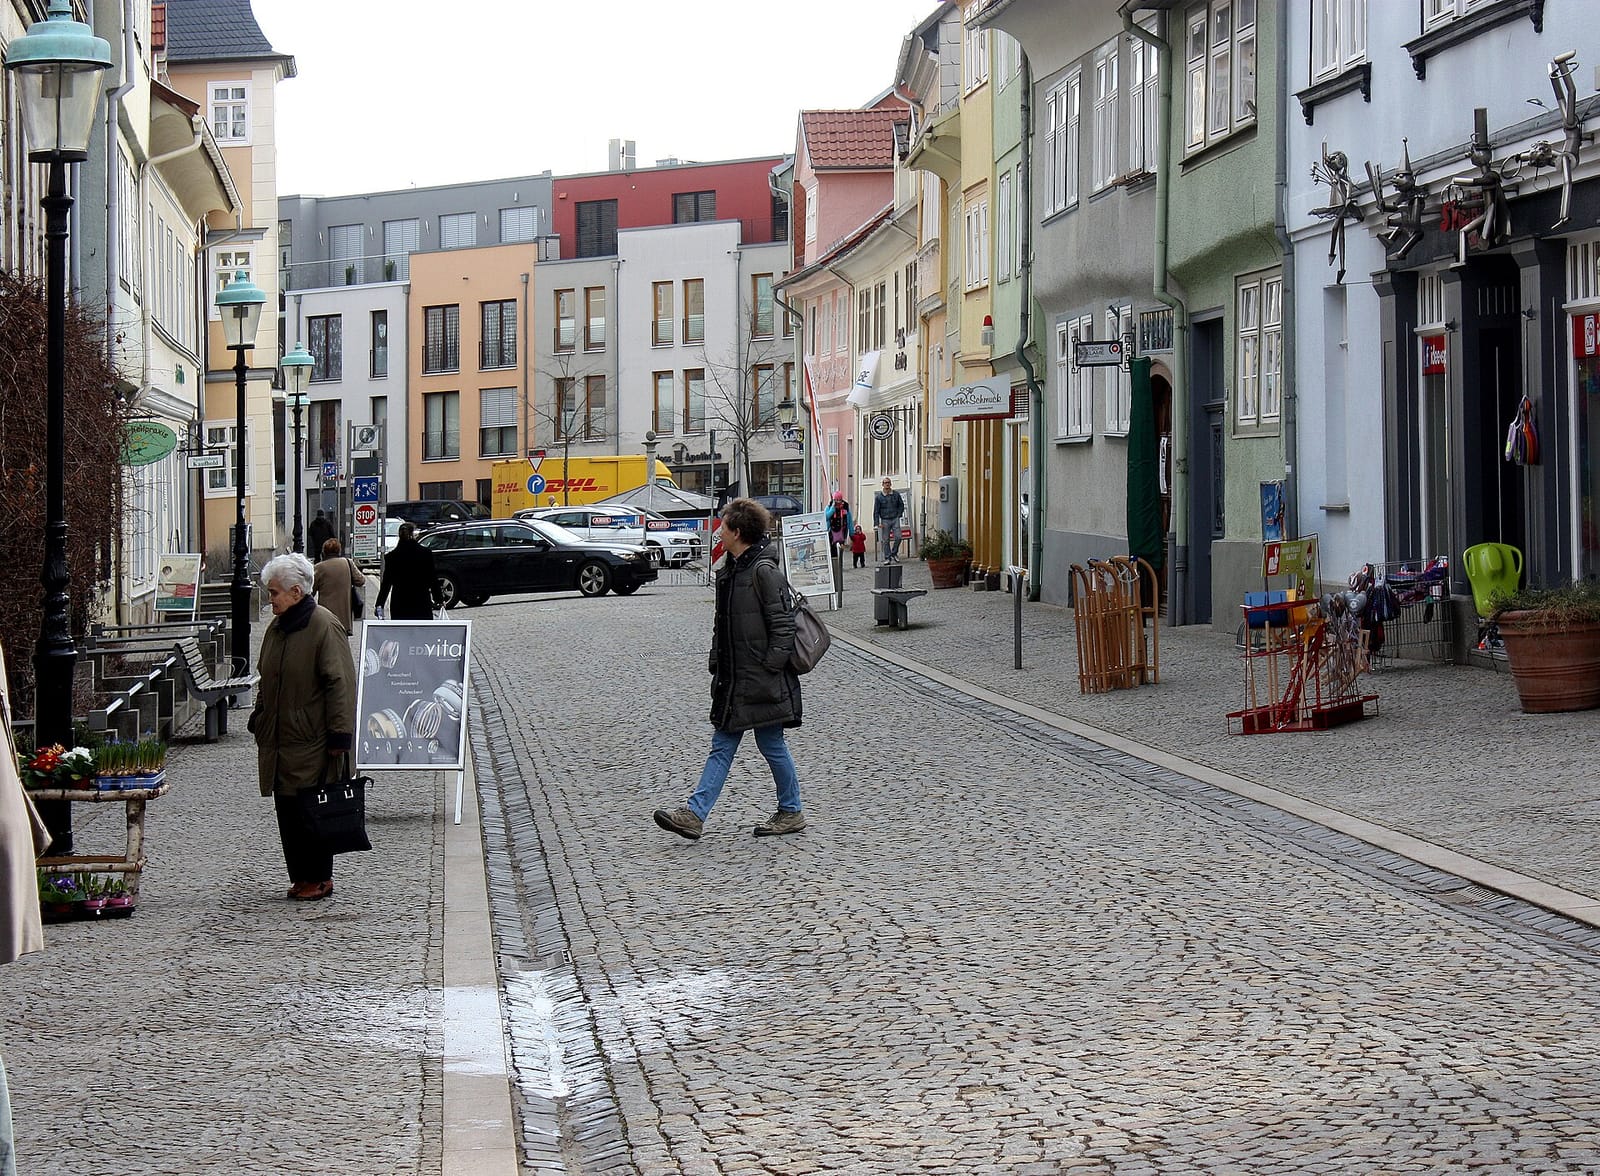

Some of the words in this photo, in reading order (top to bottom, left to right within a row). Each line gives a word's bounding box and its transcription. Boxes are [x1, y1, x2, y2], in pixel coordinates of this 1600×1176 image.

[497, 482, 518, 494] DHL
[544, 478, 598, 493] DHL
[356, 510, 375, 520] STOP
